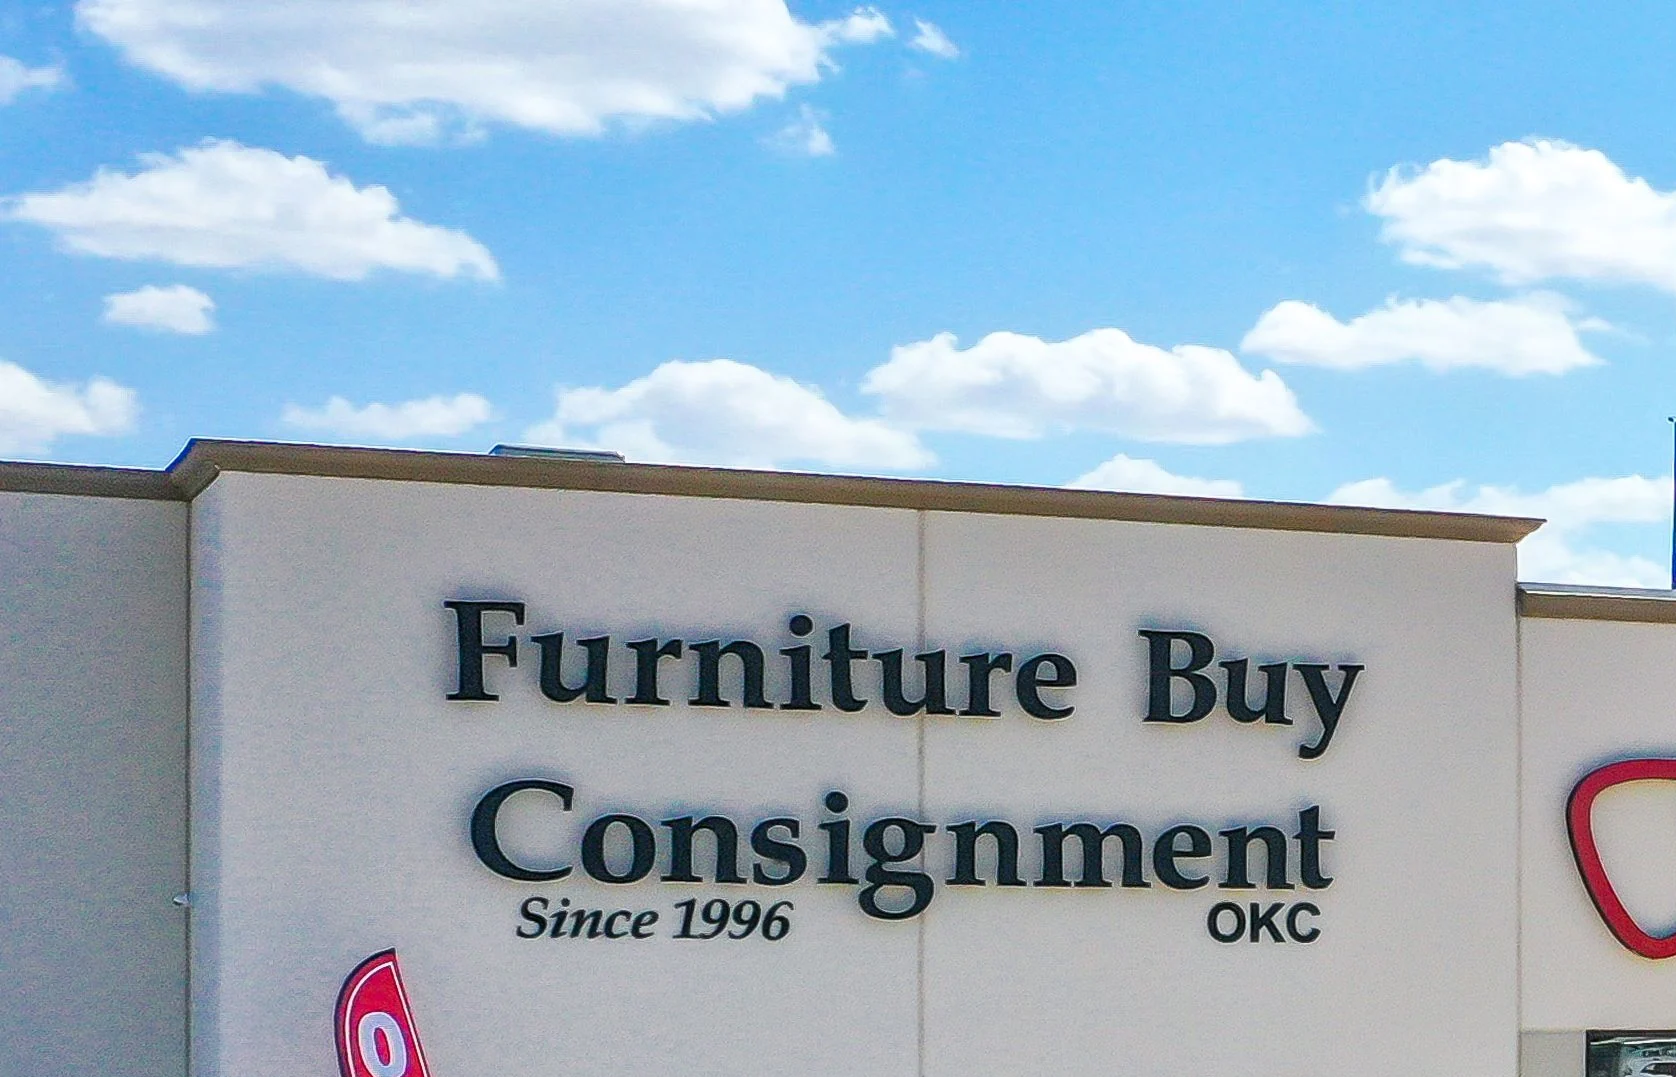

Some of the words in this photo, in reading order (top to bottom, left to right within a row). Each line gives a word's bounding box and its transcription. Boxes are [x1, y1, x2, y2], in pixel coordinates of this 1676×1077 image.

[444, 599, 1077, 722] Furniture
[1138, 629, 1365, 760] Buy
[470, 779, 1336, 921] Consignment
[515, 897, 659, 943] Since
[673, 897, 793, 943] 1996
[1207, 900, 1323, 945] OKC
